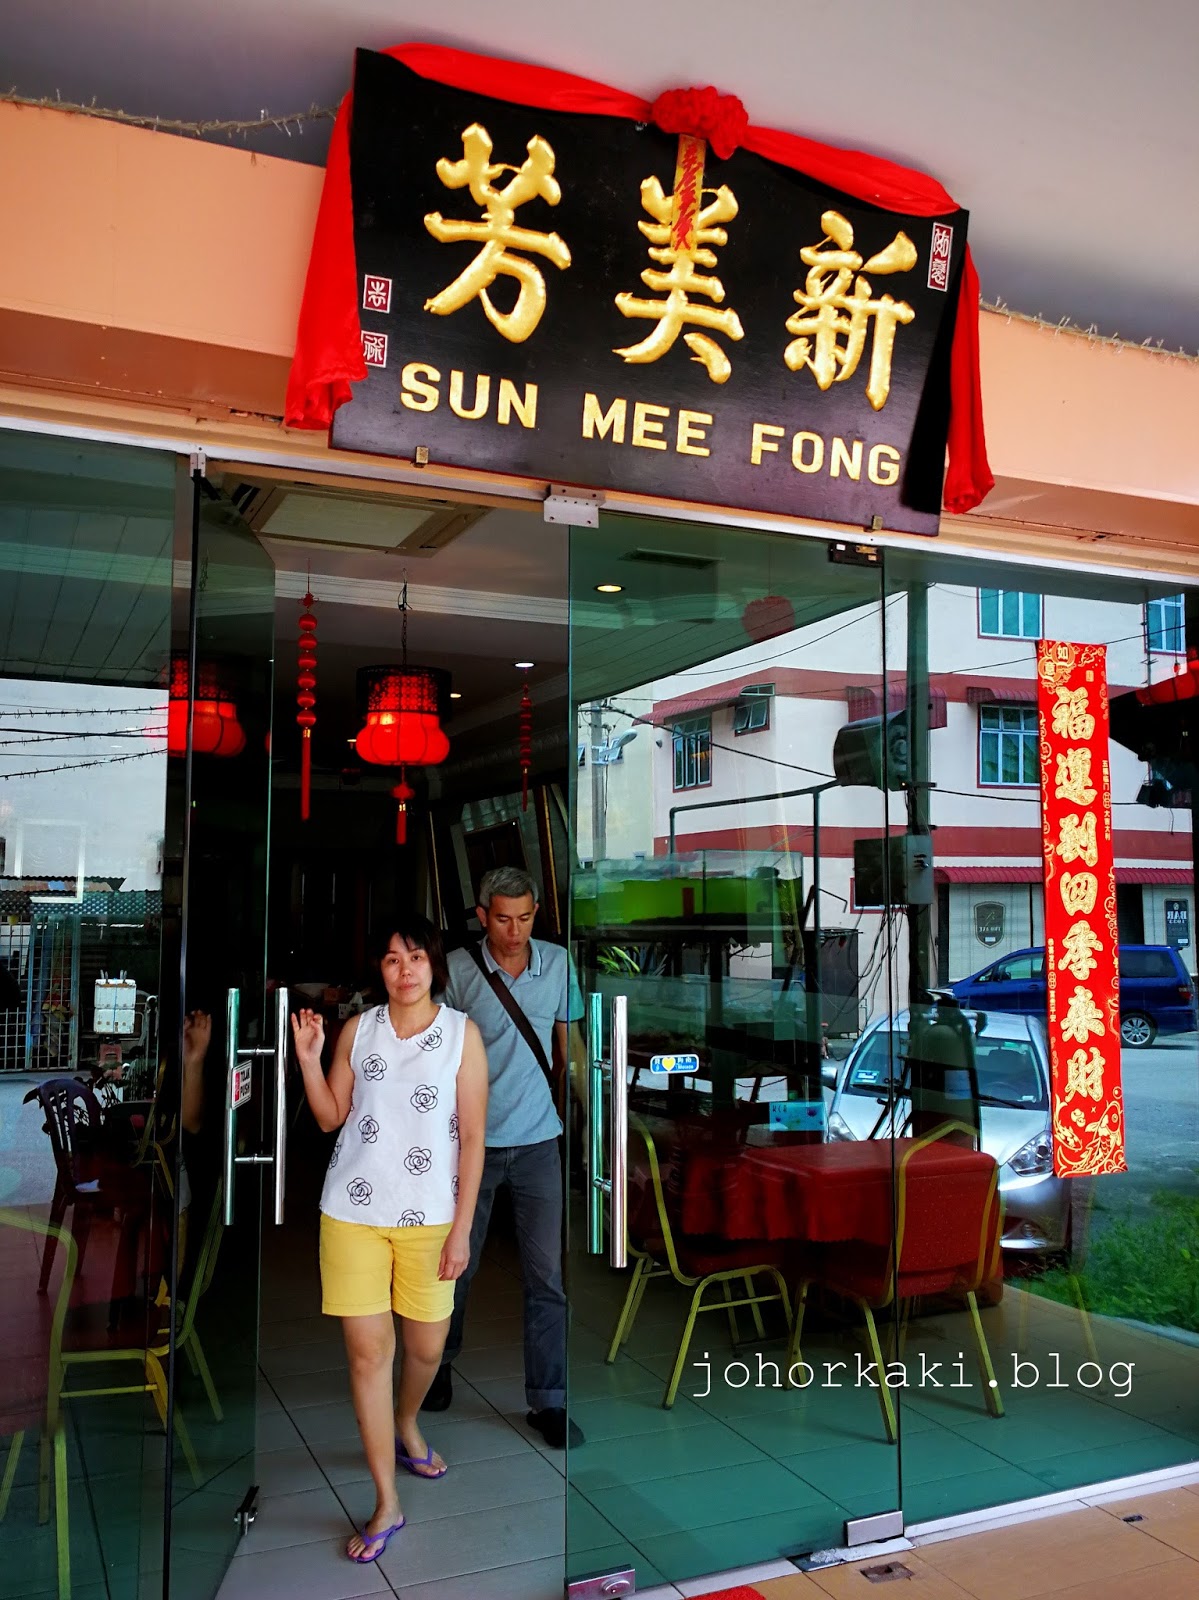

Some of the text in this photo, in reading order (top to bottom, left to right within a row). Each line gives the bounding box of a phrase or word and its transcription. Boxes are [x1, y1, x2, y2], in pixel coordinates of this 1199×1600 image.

[401, 363, 901, 486] SUN MEE FONG
